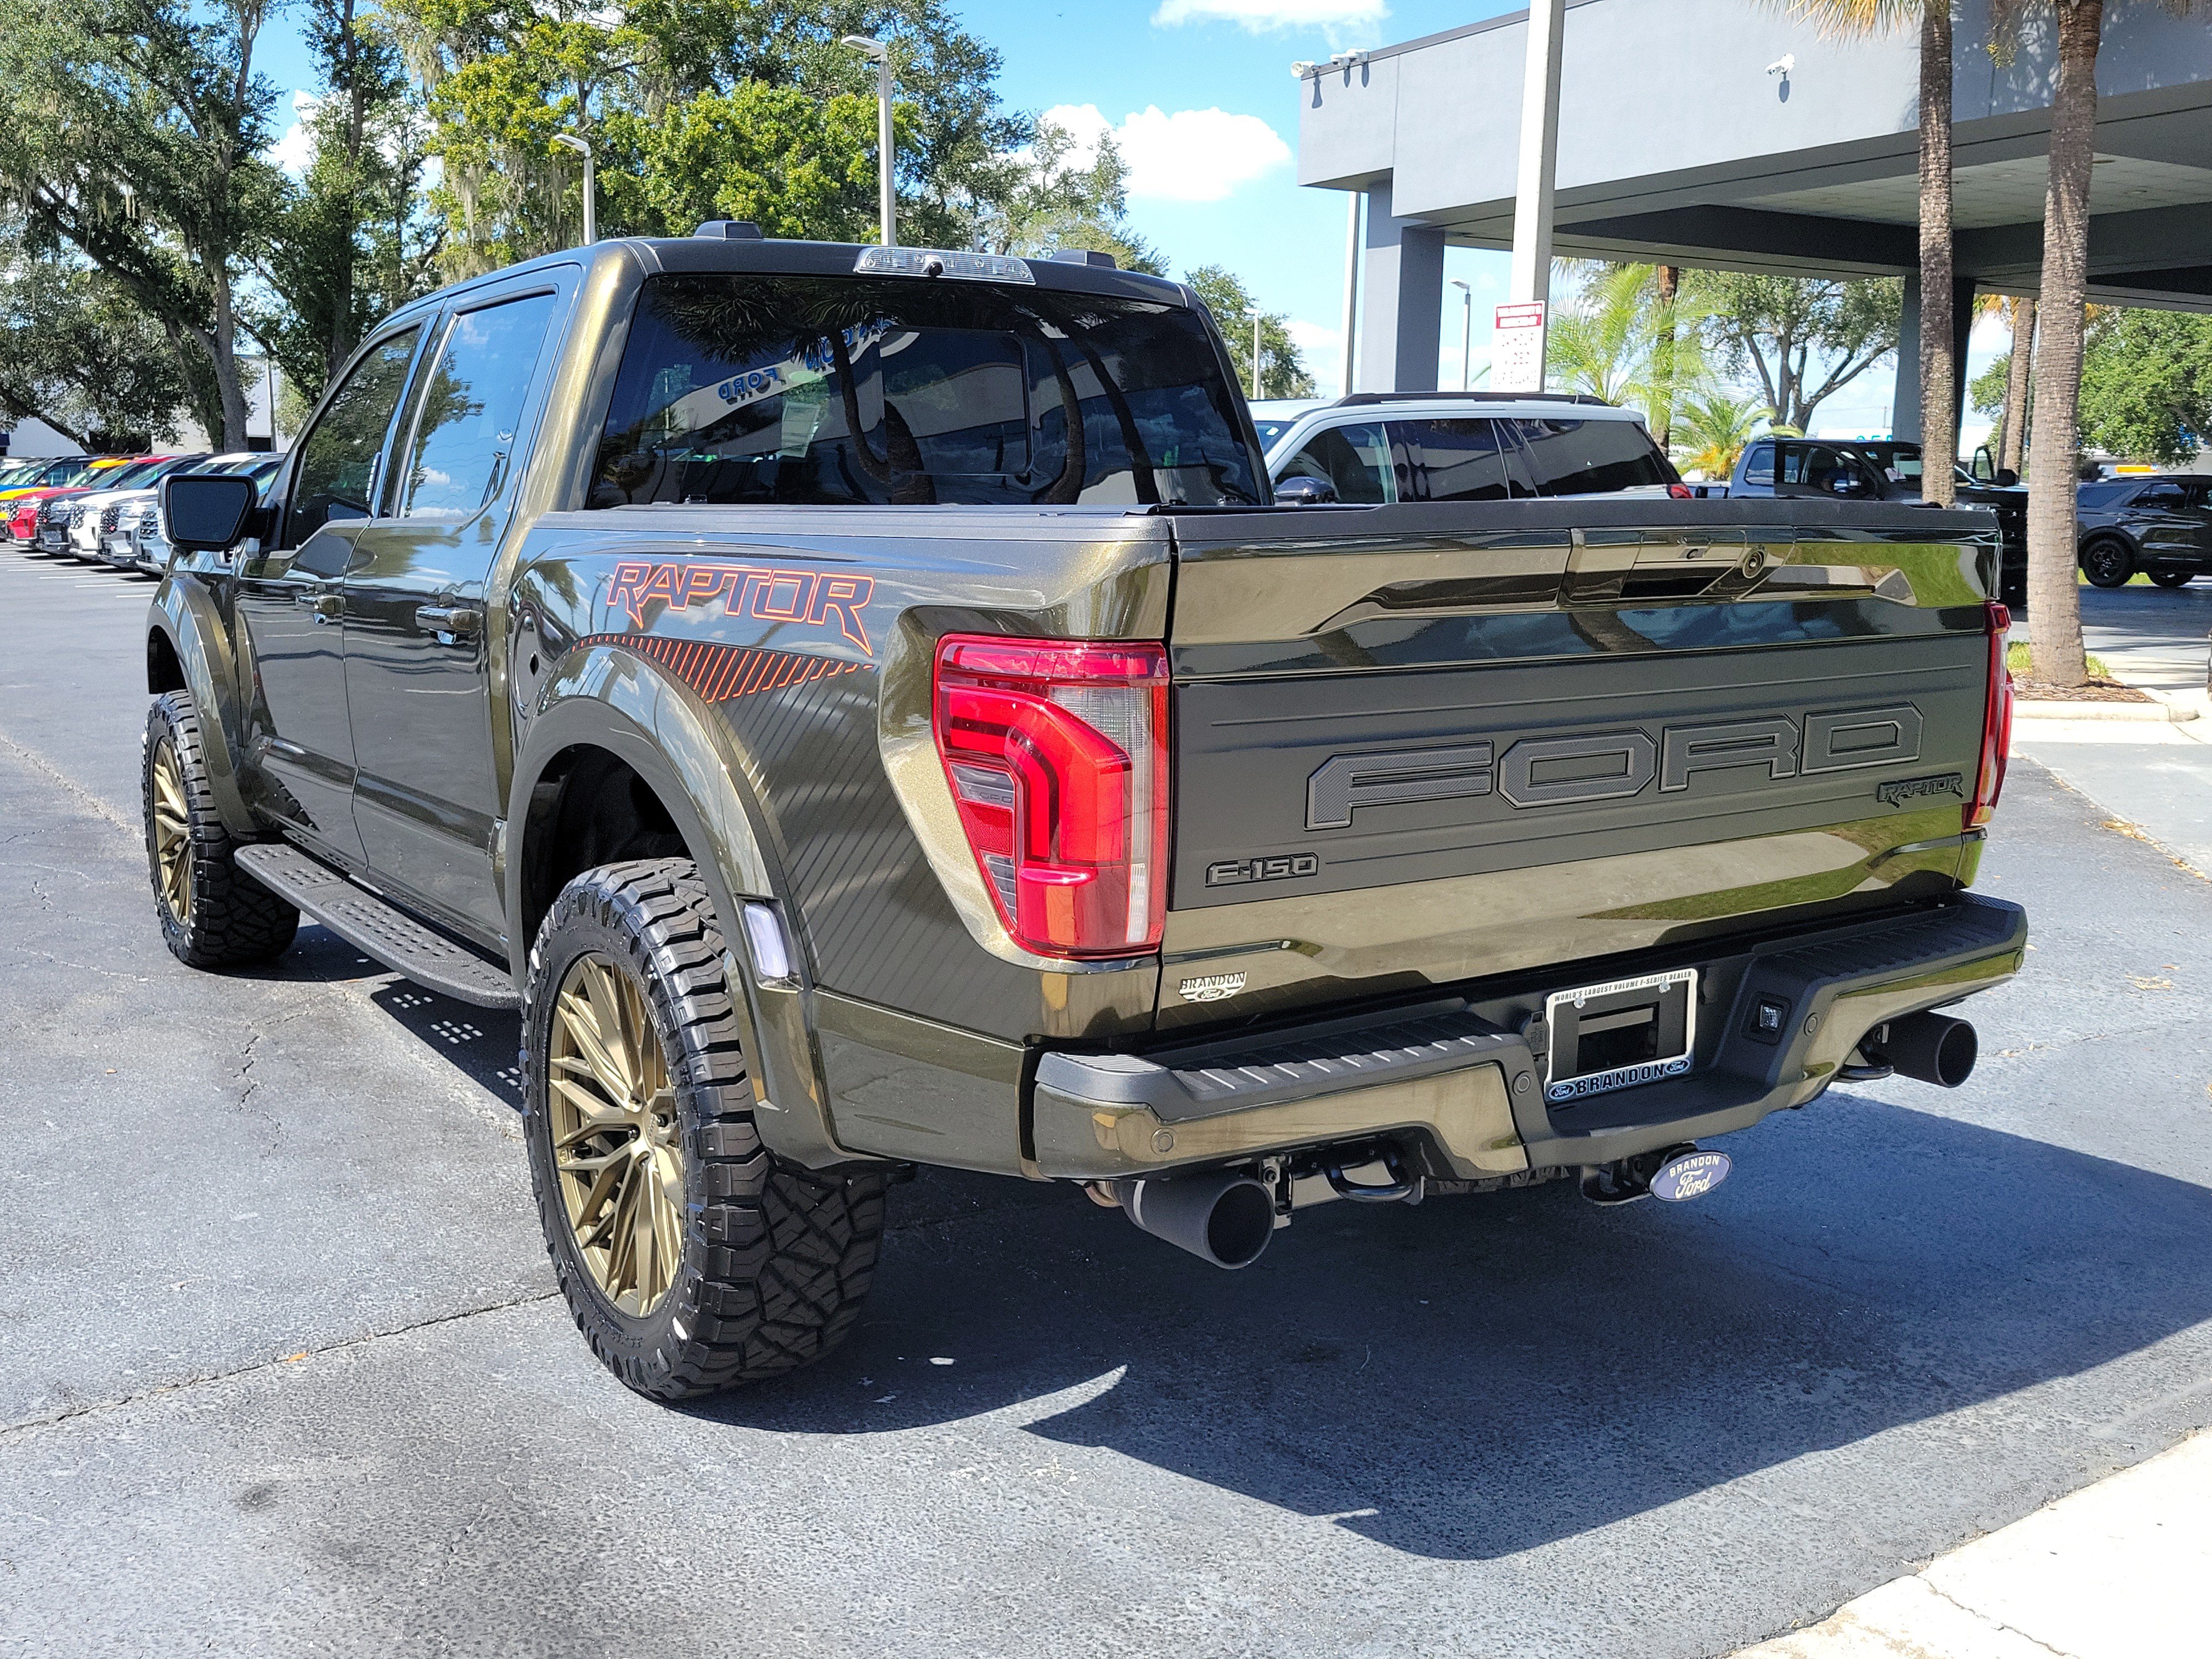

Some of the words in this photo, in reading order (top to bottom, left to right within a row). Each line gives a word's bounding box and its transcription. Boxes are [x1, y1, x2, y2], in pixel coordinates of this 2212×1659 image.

[606, 562, 875, 657] RAPTOR
[1305, 701, 1923, 831] FORD
[1877, 772, 1964, 808] RAPTOR
[1206, 852, 1318, 887] F-150
[1181, 971, 1245, 990] BRANDON
[1554, 990, 1583, 1002] WORLD'S
[1584, 985, 1613, 996] LARGEST
[1613, 979, 1638, 990] VOLUME
[1639, 974, 1667, 986] F-SERIES
[1669, 970, 1691, 980] DEALER
[1575, 1063, 1666, 1096] BRANDON
[1669, 1155, 1720, 1178] BRANDON
[1675, 1168, 1712, 1199] Ford
